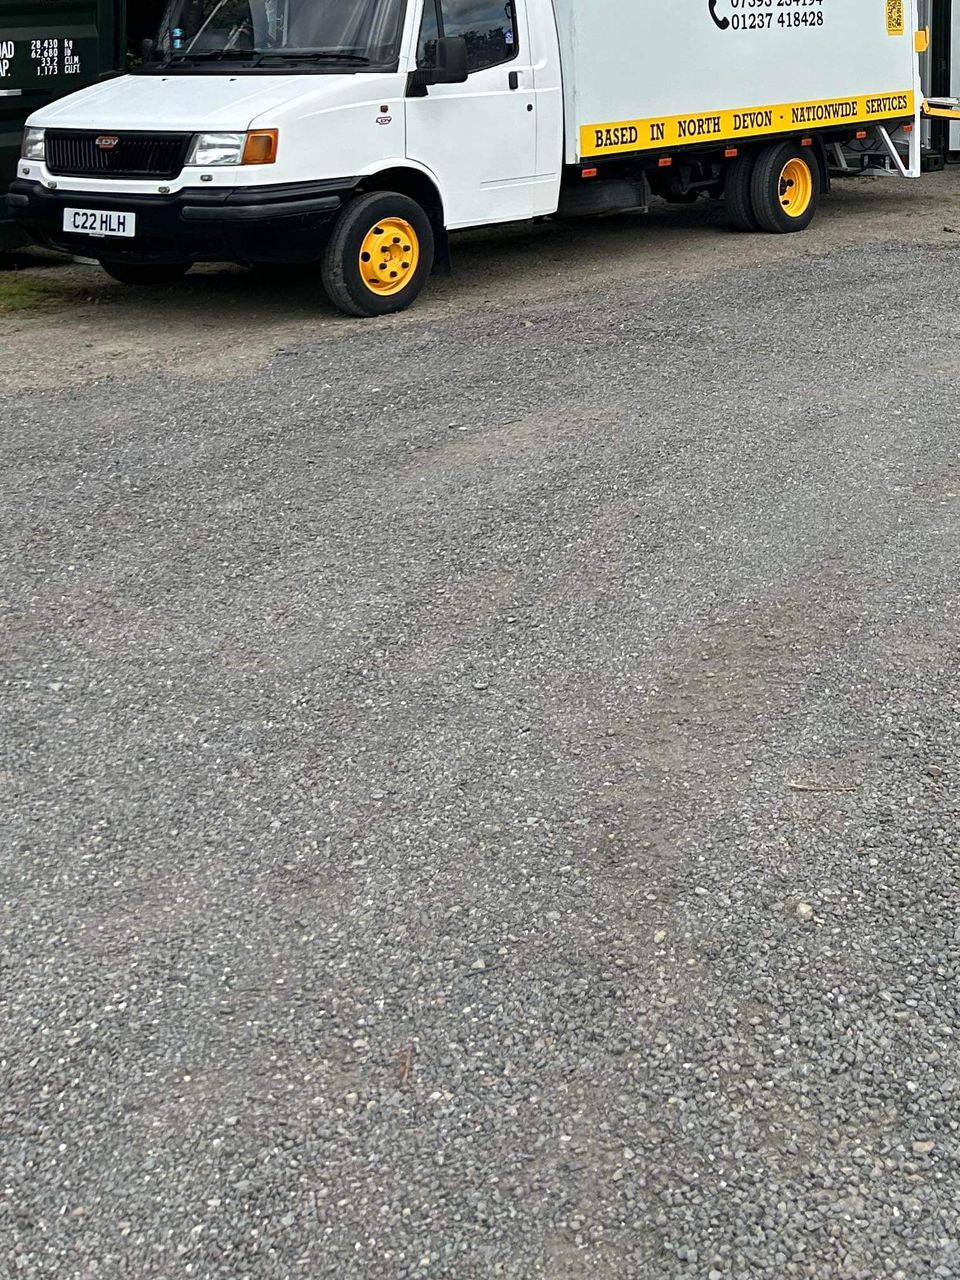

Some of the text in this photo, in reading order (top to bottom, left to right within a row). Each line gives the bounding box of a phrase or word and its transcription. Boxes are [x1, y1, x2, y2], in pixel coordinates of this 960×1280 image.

[731, 11, 824, 30] 01237 418428
[0, 38, 73, 59] AD 28.430 kg
[37, 66, 58, 76] 1.173
[594, 125, 638, 148] BASED
[650, 122, 665, 141] IN
[678, 116, 721, 138] NORTH
[733, 110, 773, 131] DEVON
[791, 101, 858, 124] NATIONWIDE
[866, 95, 908, 114] SERVICES
[73, 212, 126, 233] C22 HLH
